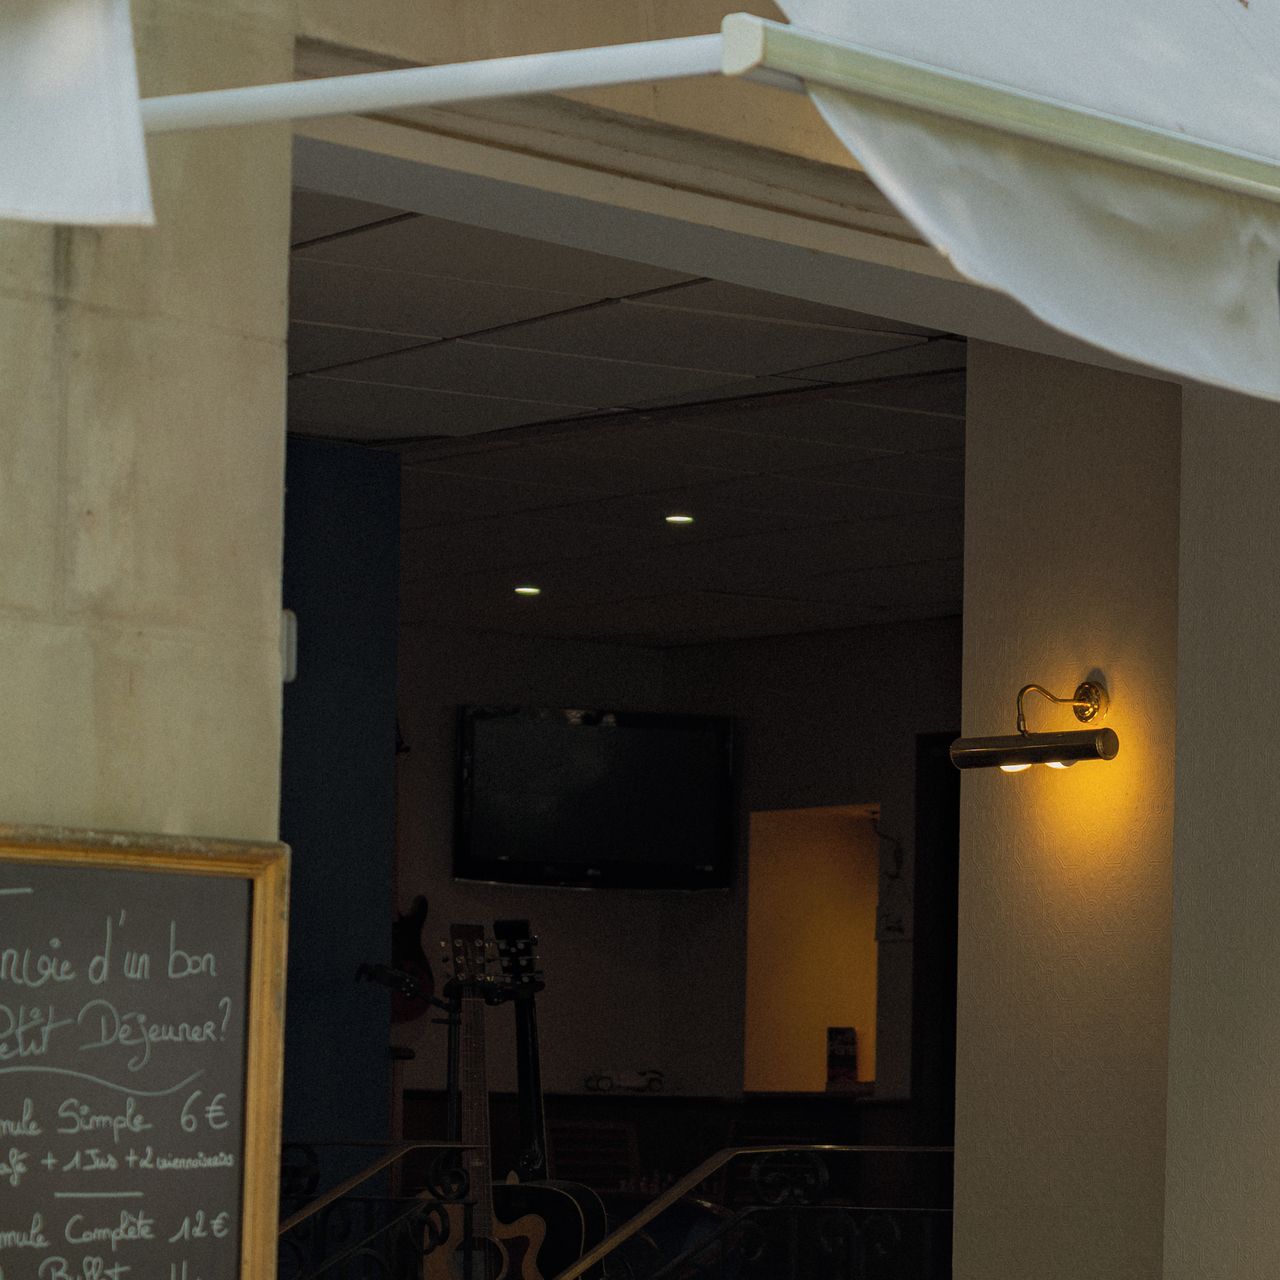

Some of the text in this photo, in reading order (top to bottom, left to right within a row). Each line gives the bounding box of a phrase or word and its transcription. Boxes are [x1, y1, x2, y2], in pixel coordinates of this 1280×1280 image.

[88, 909, 150, 984] d'un
[168, 920, 217, 979] bon
[57, 1097, 152, 1144] Simple
